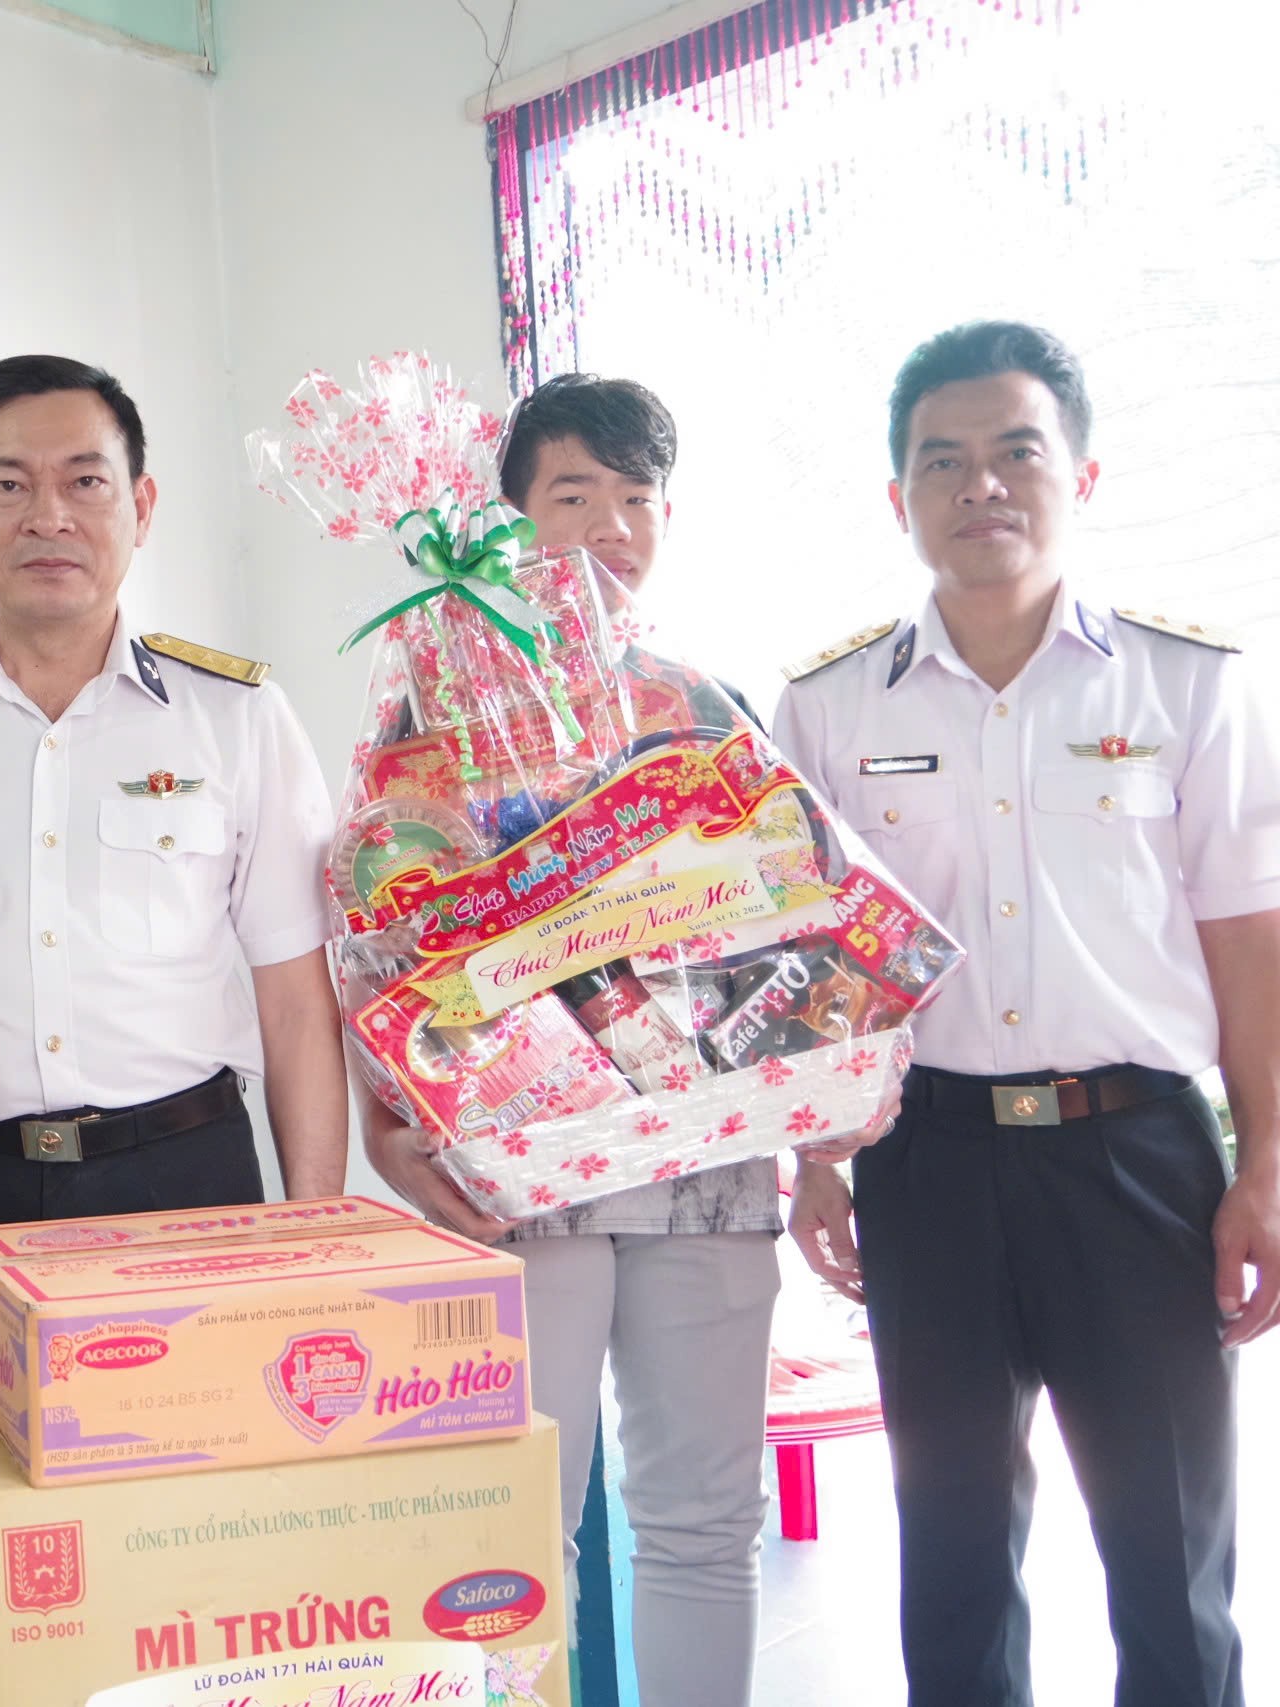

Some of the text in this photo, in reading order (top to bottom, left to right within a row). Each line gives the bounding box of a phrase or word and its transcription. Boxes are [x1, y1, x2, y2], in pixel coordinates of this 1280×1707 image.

[454, 795, 661, 922] Chúc Mừng Năm Mới
[503, 822, 668, 928] HAPPY NEW YEAR
[592, 899, 613, 913] 171
[616, 891, 638, 906] HẢI
[640, 880, 676, 897] QUÂN
[743, 903, 765, 915] 2025
[827, 877, 876, 924] ẶNG
[846, 899, 886, 957] 5 gói
[479, 951, 560, 987] Chúc
[198, 1299, 376, 1326] SẢN PHẨM VỚI CÔNG NGHỆ NHẬT BẢN
[74, 1322, 168, 1344] Cook happiness
[295, 1355, 306, 1376] 1
[312, 1363, 359, 1379] CANXI
[295, 1380, 310, 1402] 3
[374, 1366, 441, 1416] Hảo
[446, 1349, 513, 1399] Hảo
[139, 1396, 154, 1408] 10
[158, 1394, 174, 1408] 24
[200, 1389, 222, 1403] SG
[225, 1387, 233, 1401] 2
[45, 1407, 76, 1425] NSX:
[420, 1407, 516, 1429] MÌ TÔM CHUA CAY
[46, 1451, 70, 1464] (HSD
[73, 1450, 88, 1461] sản
[90, 1446, 114, 1461] phẩm
[128, 1445, 134, 1456] 5
[210, 1434, 225, 1446] sản
[125, 1527, 168, 1552] CÔNG
[171, 1526, 191, 1547] TY
[195, 1513, 216, 1544] CỔ
[220, 1509, 260, 1541] PHẦN
[263, 1510, 313, 1535] LƯƠNG
[317, 1503, 358, 1528] THỰC
[369, 1497, 410, 1523] THỰC
[413, 1484, 455, 1515] PHẨM
[457, 1485, 511, 1511] SAFOCO
[32, 1535, 55, 1554] 10
[455, 1582, 516, 1607] Safoco
[12, 1621, 84, 1643] ISO 9001
[134, 1593, 391, 1672] MÌ TRỨNG
[194, 1652, 385, 1691] LỮ ĐOÀN 171 HẢI QUÂN
